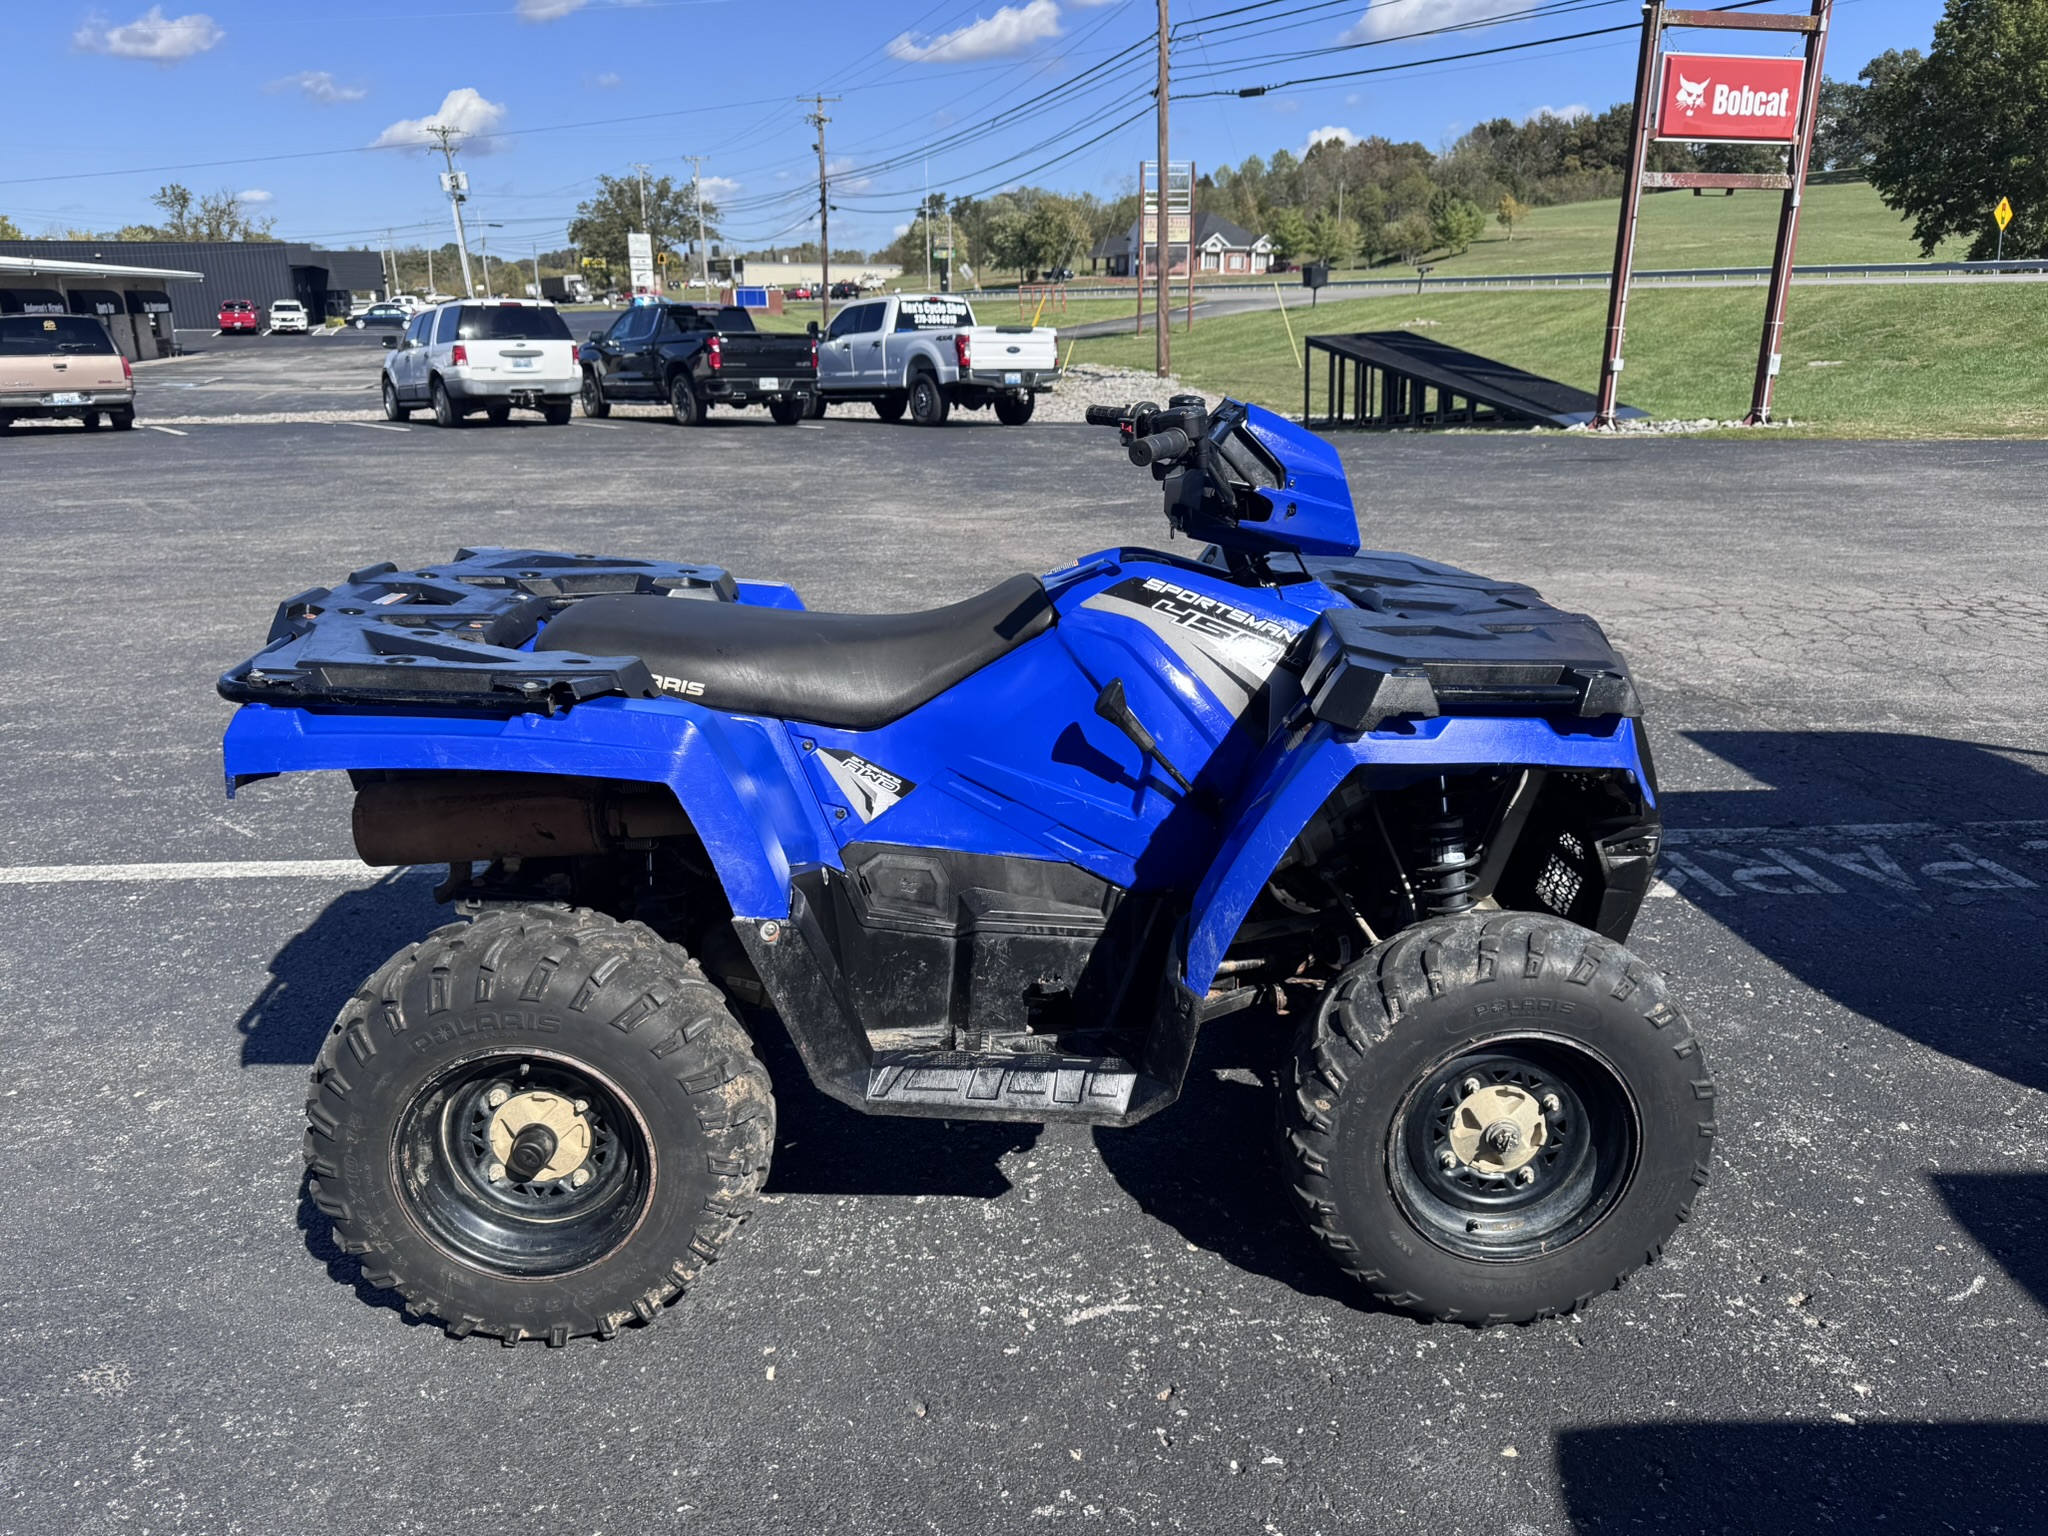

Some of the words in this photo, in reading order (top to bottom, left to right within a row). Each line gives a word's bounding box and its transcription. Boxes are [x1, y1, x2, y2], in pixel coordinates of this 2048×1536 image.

[1712, 84, 1789, 117] Bobcat
[924, 301, 947, 315] Cycle
[947, 302, 967, 316] Shop
[1143, 577, 1298, 643] SPORTSMAN
[840, 758, 900, 792] AWD
[1474, 997, 1576, 1018] POLARIS
[408, 1010, 561, 1054] POLARIS
